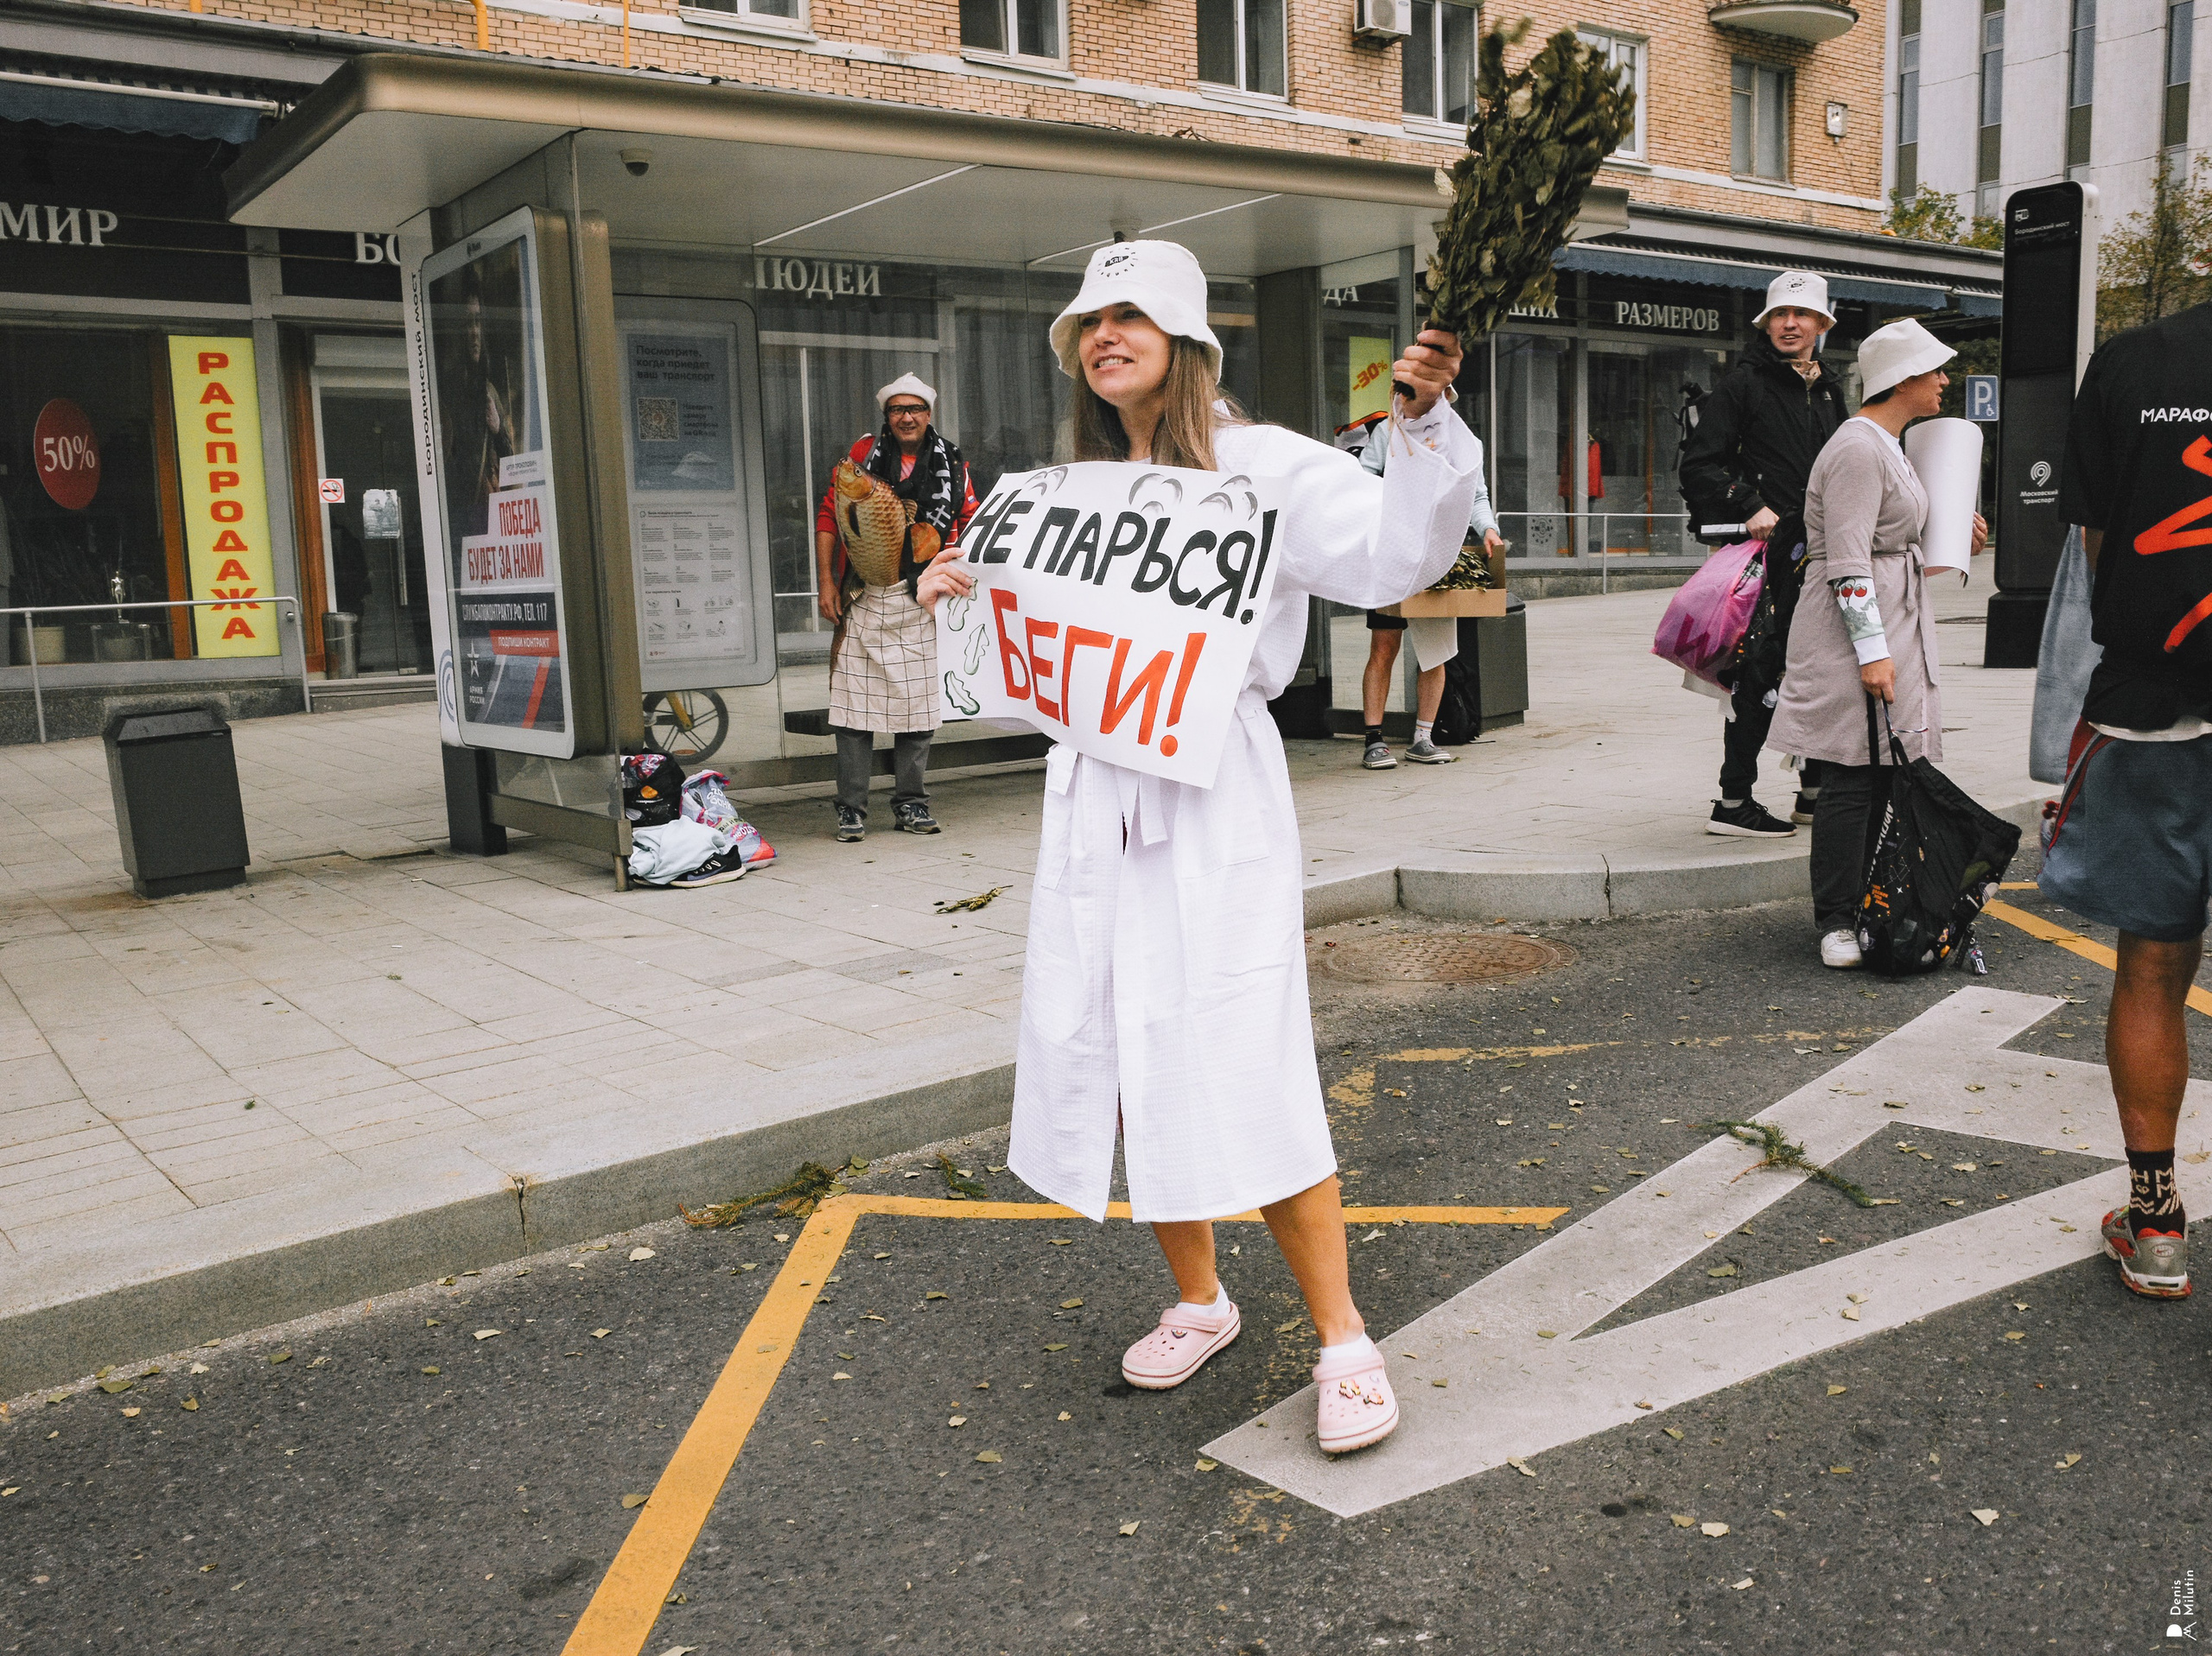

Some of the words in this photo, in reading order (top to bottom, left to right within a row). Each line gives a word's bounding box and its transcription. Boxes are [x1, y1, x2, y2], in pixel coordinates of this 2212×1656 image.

[0, 201, 118, 246] МИР
[411, 271, 423, 323] мост
[1617, 301, 1719, 332] РАЗМЕРОВ
[637, 359, 665, 369] когда
[663, 372, 715, 381] транспорт
[1352, 359, 1389, 391] -30%
[414, 331, 433, 476] Бородинский
[1974, 381, 1993, 416] P
[2140, 407, 2212, 423] МАРАФ
[43, 435, 95, 473] 50%
[197, 352, 261, 640] РАСПРОДАЖА
[2020, 488, 2059, 497] Московский
[499, 497, 542, 539] ПОБЕДА
[467, 545, 497, 585] БУДЕТ
[499, 544, 512, 580] ЗА
[512, 542, 544, 579] НАМИ
[956, 489, 1034, 564] НЕ
[1023, 507, 1279, 625] ПАРЬСЯ!
[537, 603, 547, 621] 117
[989, 587, 1207, 758] БЕГИ!
